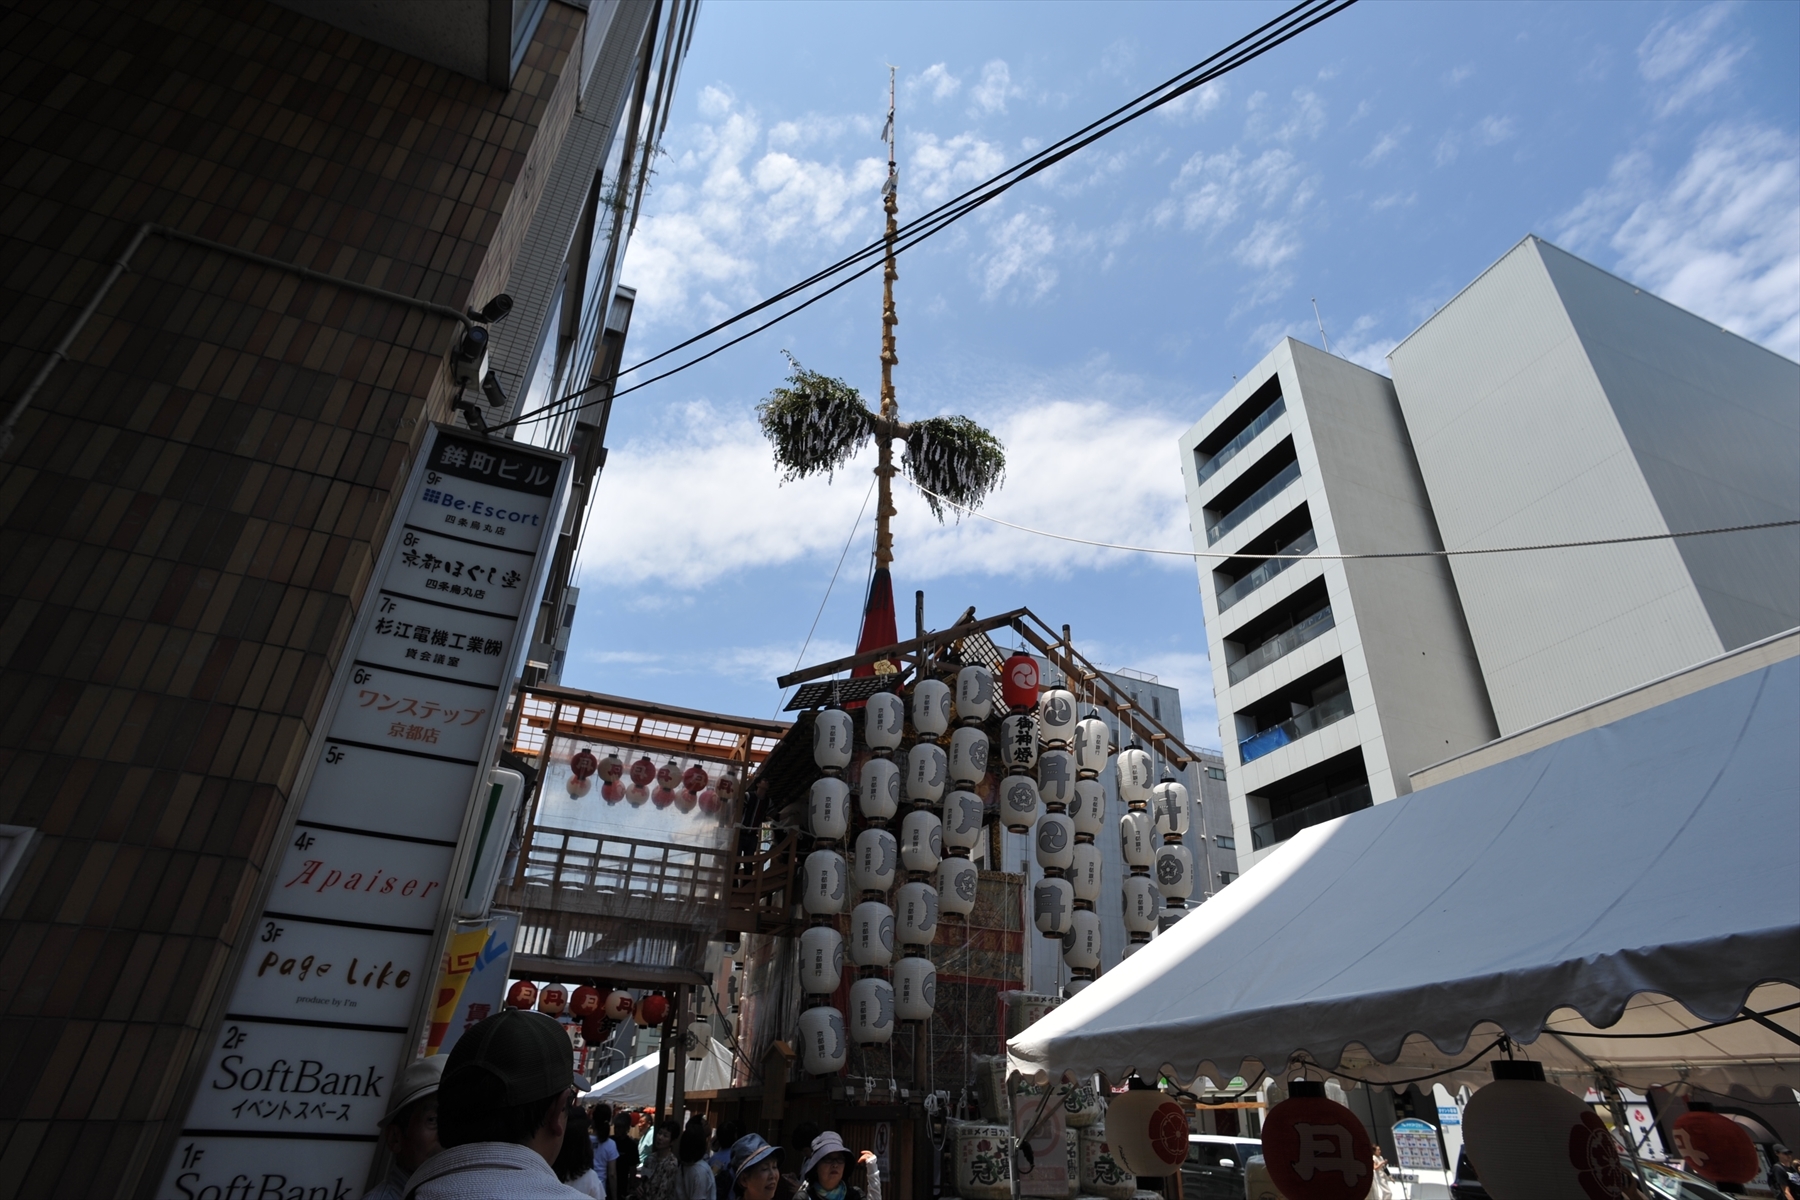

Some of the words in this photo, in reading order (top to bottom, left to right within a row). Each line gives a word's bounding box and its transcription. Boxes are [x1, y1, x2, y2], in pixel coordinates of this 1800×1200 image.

[440, 444, 550, 487] 鉾町ビル
[426, 471, 443, 486] 9F
[445, 514, 507, 536] 四条烏丸店
[403, 532, 420, 548] 8F
[402, 549, 522, 590] 京都ほぐし堂
[425, 578, 486, 600] 四条烏丸店
[379, 597, 397, 614] 7F
[353, 668, 372, 685] 6F
[358, 689, 486, 726] ワンステップ
[387, 721, 441, 745] 京都店
[325, 746, 345, 765] 5F
[294, 831, 316, 851] 4F
[285, 859, 440, 898] Apaiser
[261, 921, 284, 943] 3F
[295, 995, 330, 1005] produce
[332, 998, 343, 1007] by
[221, 1026, 247, 1050] 2F
[212, 1055, 385, 1098] SoftBank
[231, 1098, 351, 1122] イベントスペース
[181, 1142, 205, 1170] 1F
[175, 1172, 353, 1200] SoftBank
